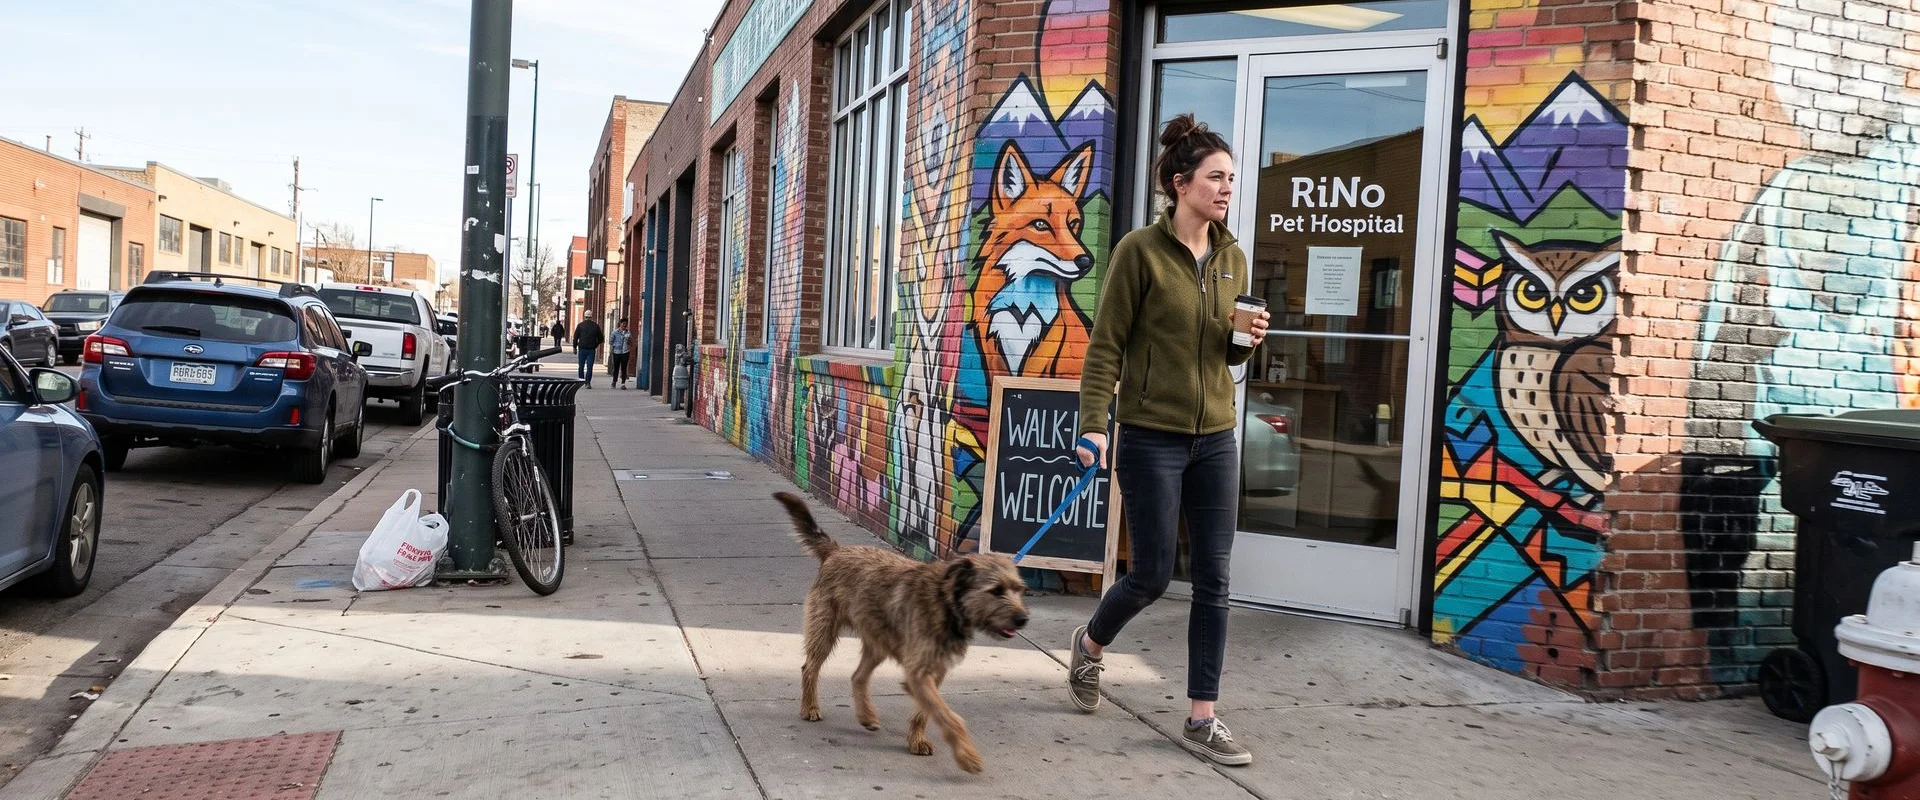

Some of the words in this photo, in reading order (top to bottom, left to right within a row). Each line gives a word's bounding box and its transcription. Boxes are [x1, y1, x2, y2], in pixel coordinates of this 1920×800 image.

[1291, 176, 1385, 208] RiNo
[1270, 213, 1304, 233] Pet
[1311, 213, 1404, 238] Hospital
[1000, 471, 1109, 529] WELCOME
